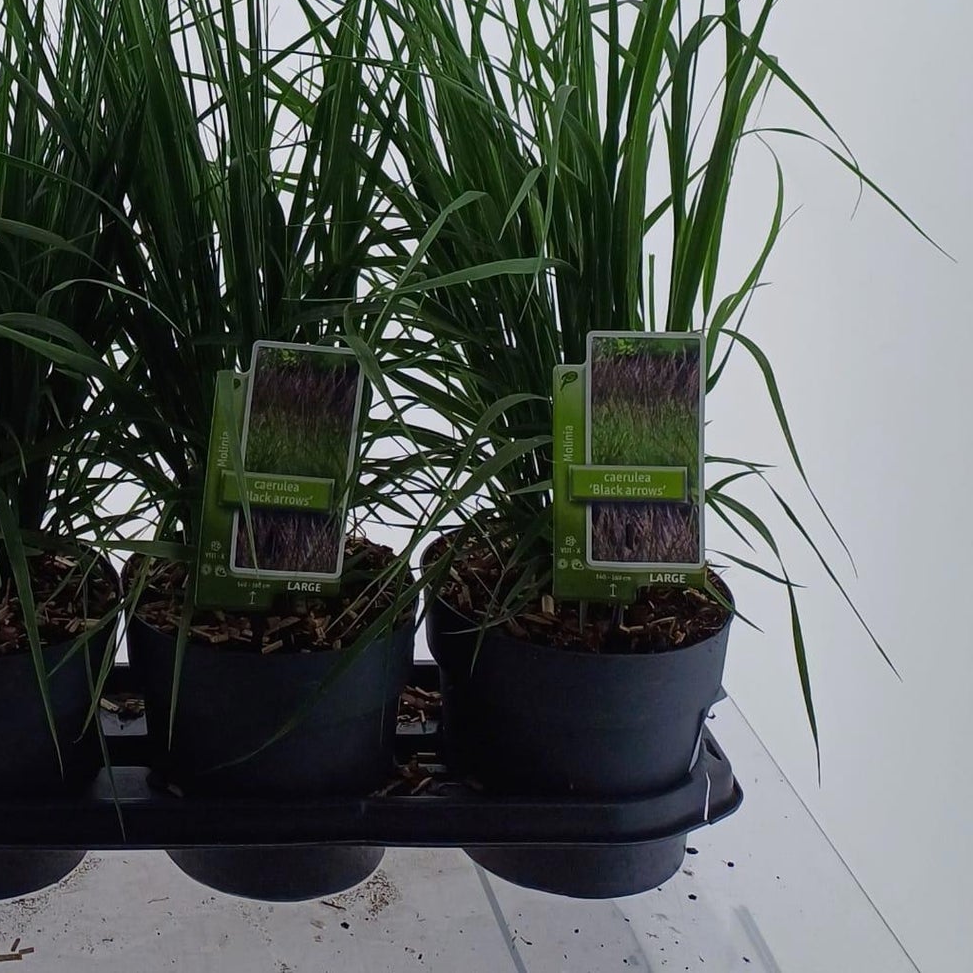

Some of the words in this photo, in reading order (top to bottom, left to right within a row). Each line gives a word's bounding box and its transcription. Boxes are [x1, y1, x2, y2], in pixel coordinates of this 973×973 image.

[217, 430, 229, 467] Molinia
[563, 425, 574, 463] Molinia
[604, 473, 652, 484] caerulea
[254, 480, 300, 493] caerulea
[589, 483, 624, 496] 'Black
[626, 484, 666, 496] arrows'
[273, 495, 314, 506] arrows'
[649, 573, 687, 584] LARGE
[287, 581, 322, 593] LARGE
